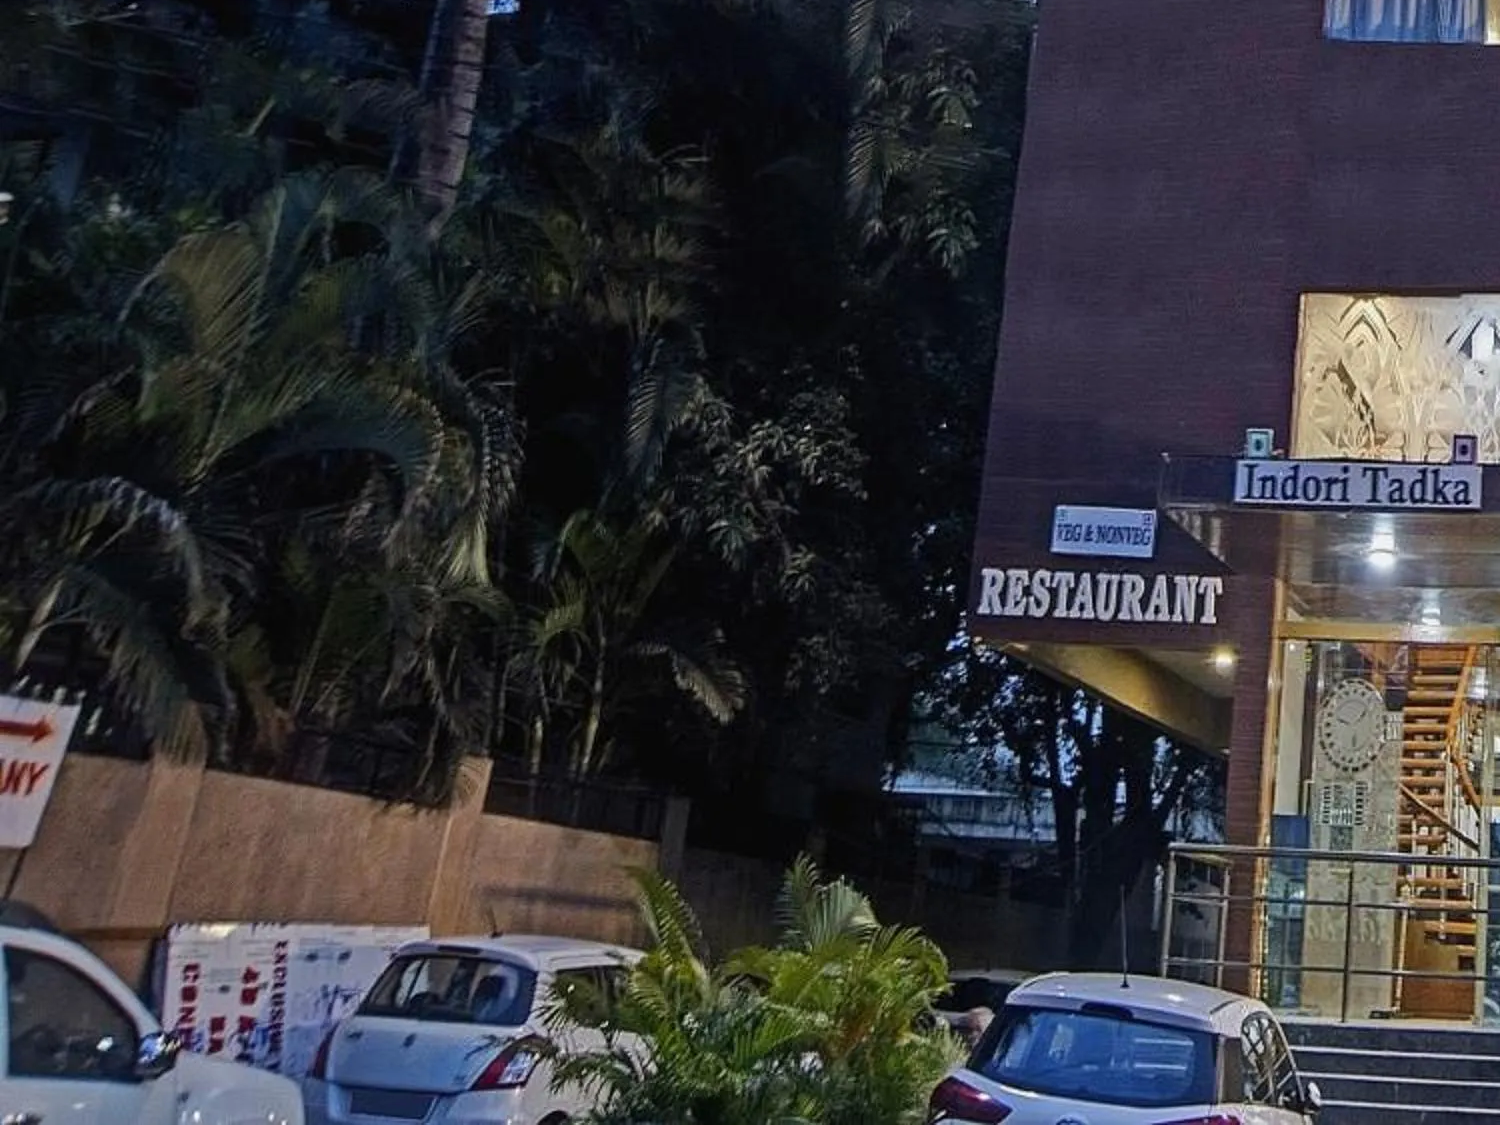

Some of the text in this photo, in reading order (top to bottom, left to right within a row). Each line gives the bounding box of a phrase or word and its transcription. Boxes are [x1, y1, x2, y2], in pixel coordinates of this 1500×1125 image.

[1242, 463, 1473, 505] Indori Tadka
[1057, 523, 1082, 542] VEG
[1083, 524, 1095, 543] &
[976, 567, 1223, 624] RESTAURANT
